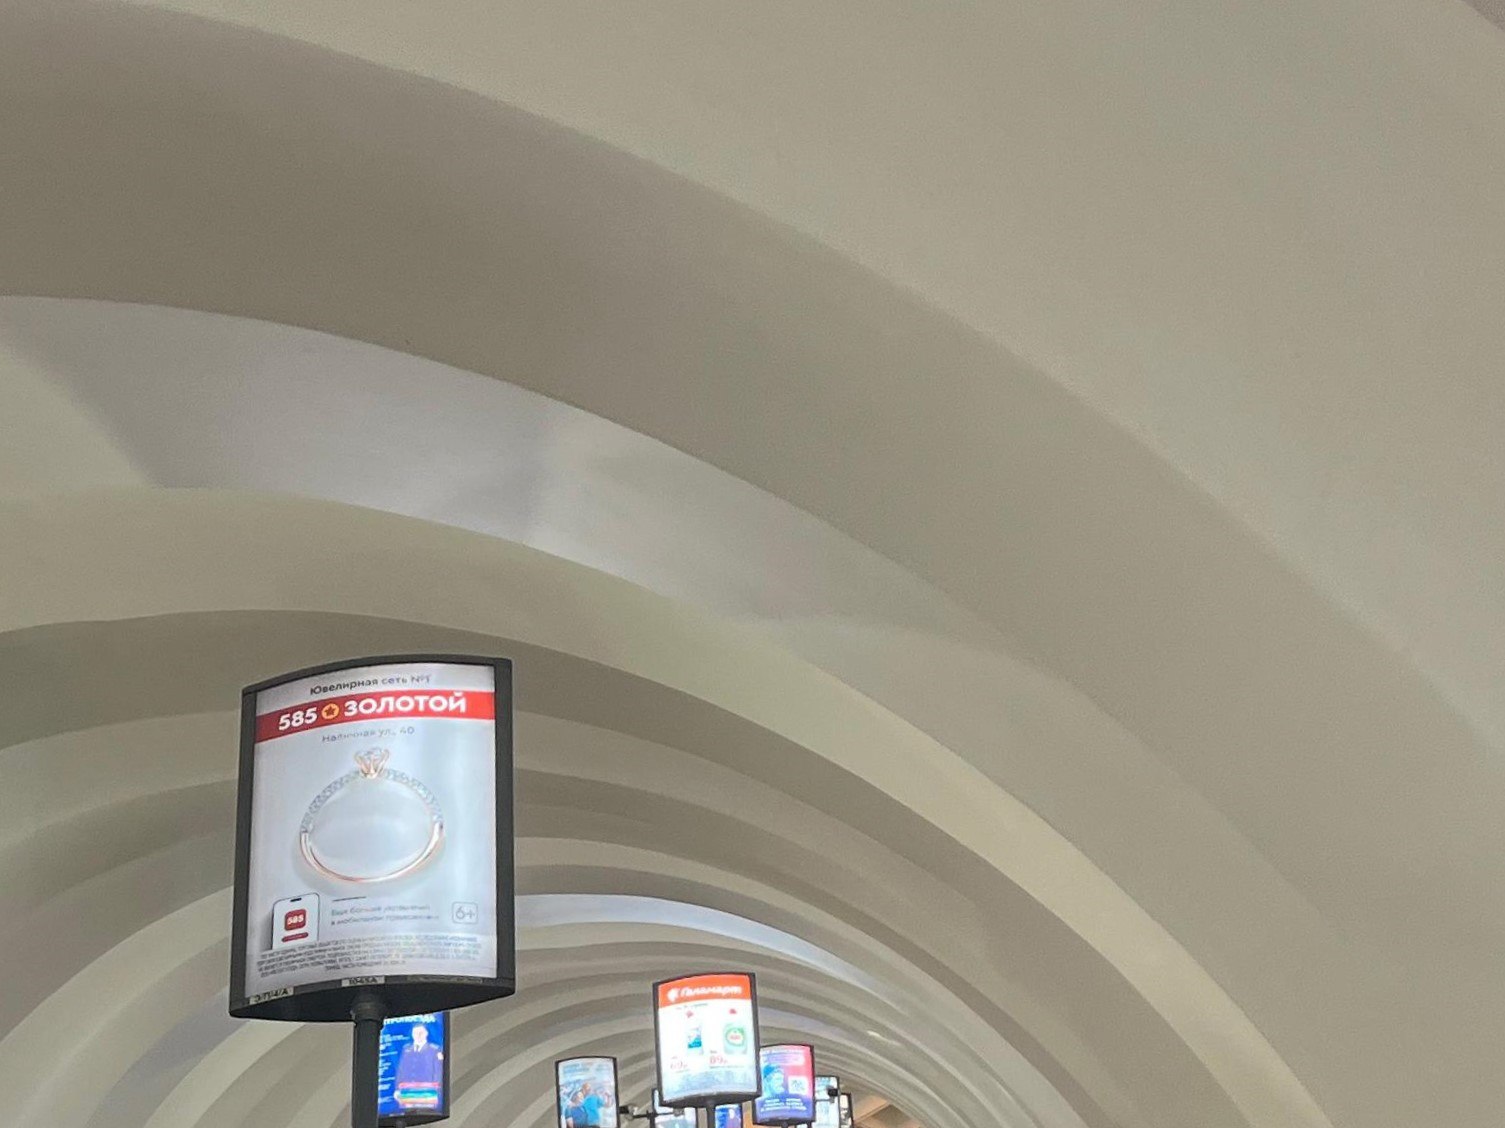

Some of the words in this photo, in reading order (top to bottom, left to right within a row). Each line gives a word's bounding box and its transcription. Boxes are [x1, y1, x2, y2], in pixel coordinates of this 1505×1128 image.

[310, 678, 378, 696] Ювелирная
[381, 677, 408, 685] сеть
[278, 706, 318, 731] 585
[343, 692, 467, 718] ЗОЛОТОЙ
[456, 906, 476, 920] 6+
